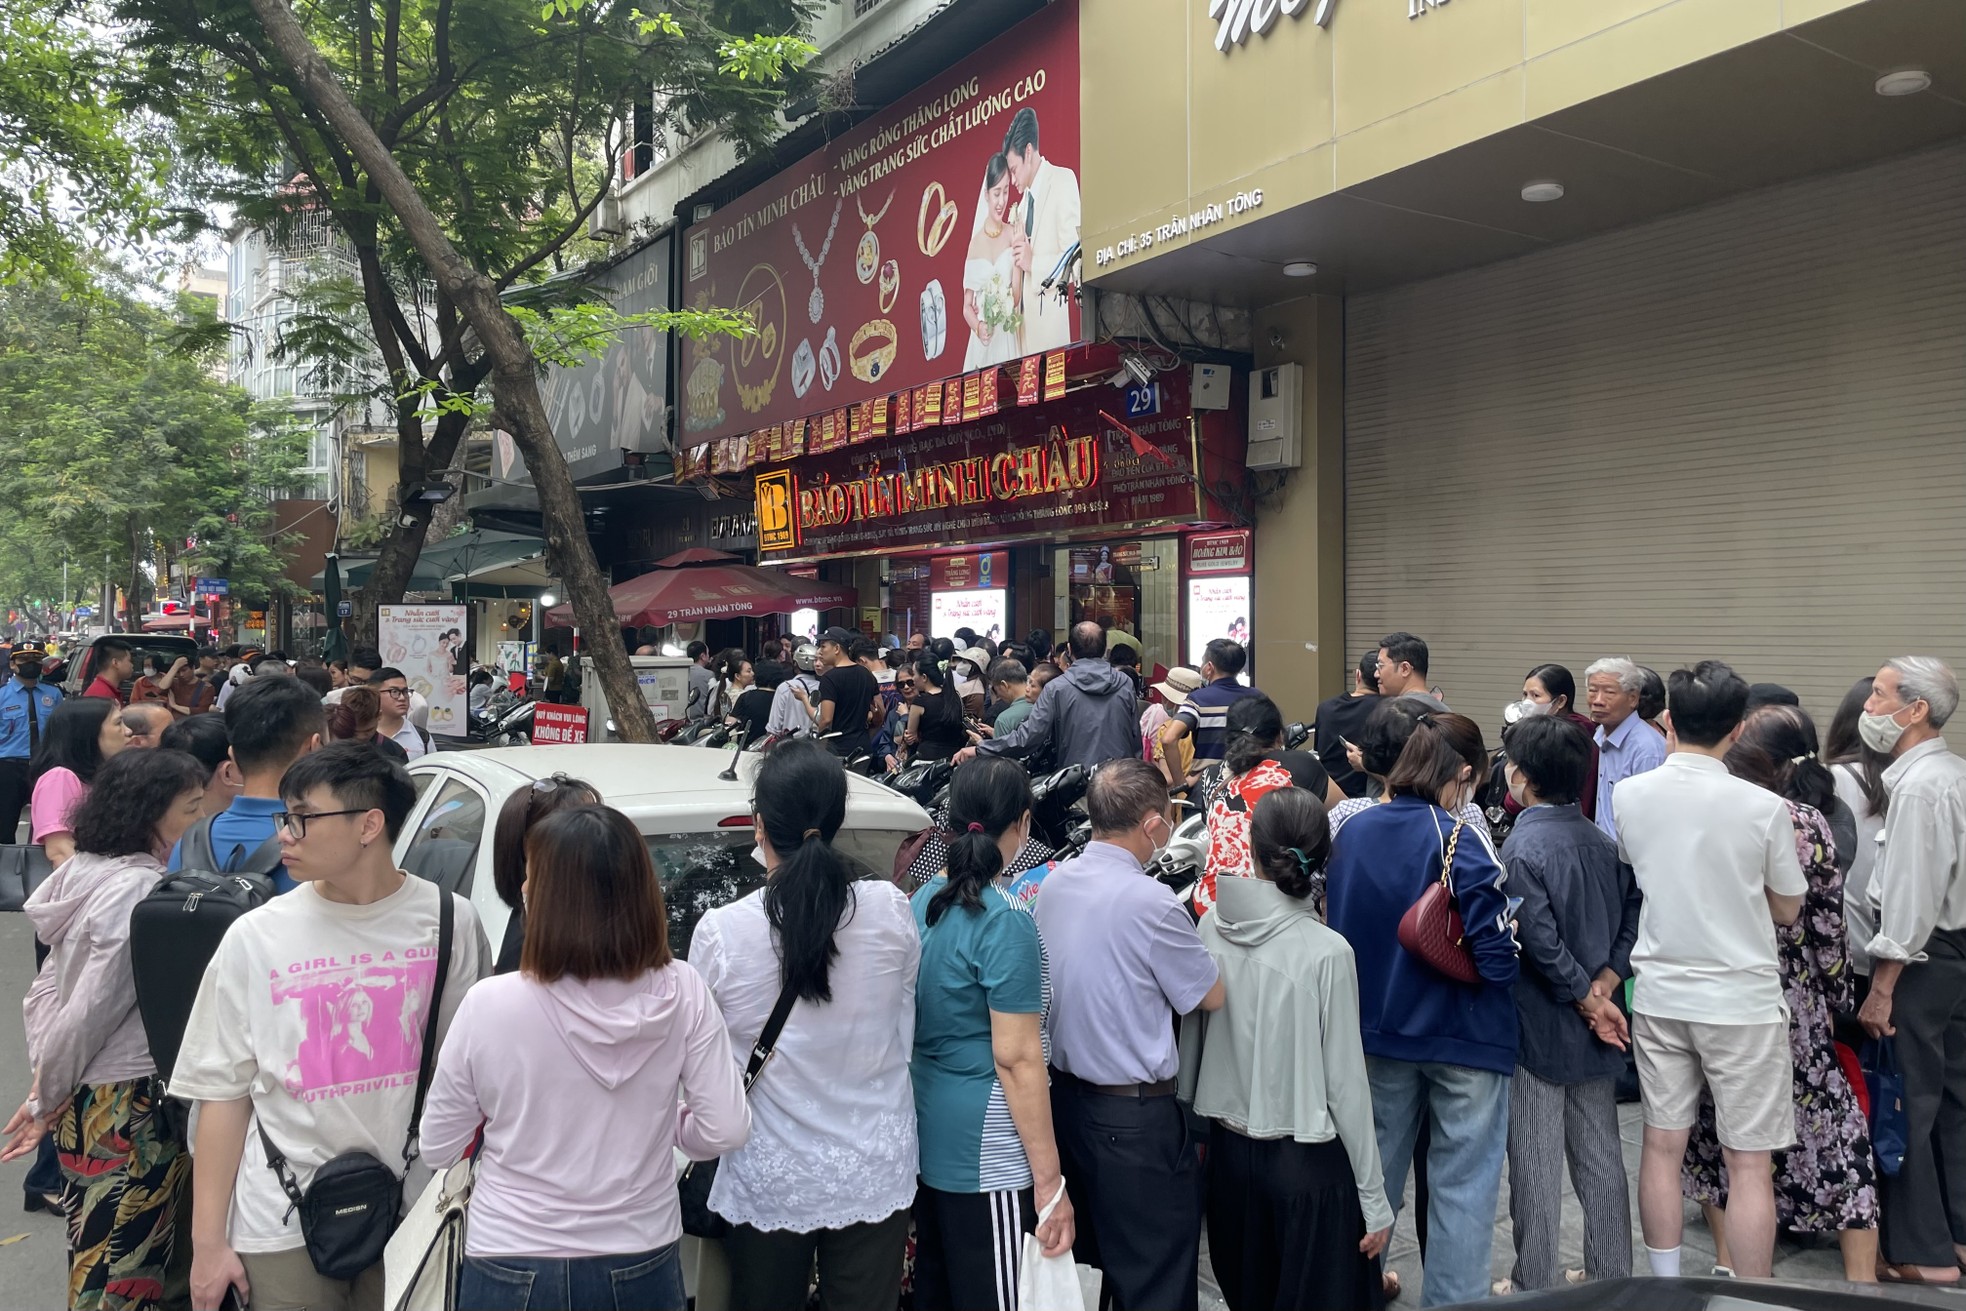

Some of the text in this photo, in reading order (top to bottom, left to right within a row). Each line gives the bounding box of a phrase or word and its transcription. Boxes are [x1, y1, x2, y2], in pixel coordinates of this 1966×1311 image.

[839, 68, 1046, 198] VÀNG TRANG SỨC CHẤT LƯỢNG CAO
[840, 76, 979, 172] VÀNG RỒNG THĂNG LONG
[714, 172, 826, 254] BẢO TÍN MINH CHÂU
[1096, 246, 1114, 266] ĐỊA
[1139, 231, 1153, 248] 35
[1155, 214, 1187, 243] TRẦN
[1189, 203, 1223, 231] NHÂN
[1226, 188, 1264, 214] TÔNG
[1130, 388, 1151, 413] 29
[799, 424, 1097, 529] BẢO TÍN MINH CHÂU
[667, 610, 678, 619] 29
[795, 595, 843, 605] www.btmc.vn
[546, 709, 562, 721] KHÁCH
[563, 713, 573, 721] VUI
[534, 724, 584, 743] KHÔNG ĐỂ XE
[270, 969, 280, 980] A
[288, 957, 341, 974] GIRL
[350, 953, 372, 965] IS
[382, 951, 395, 962] A
